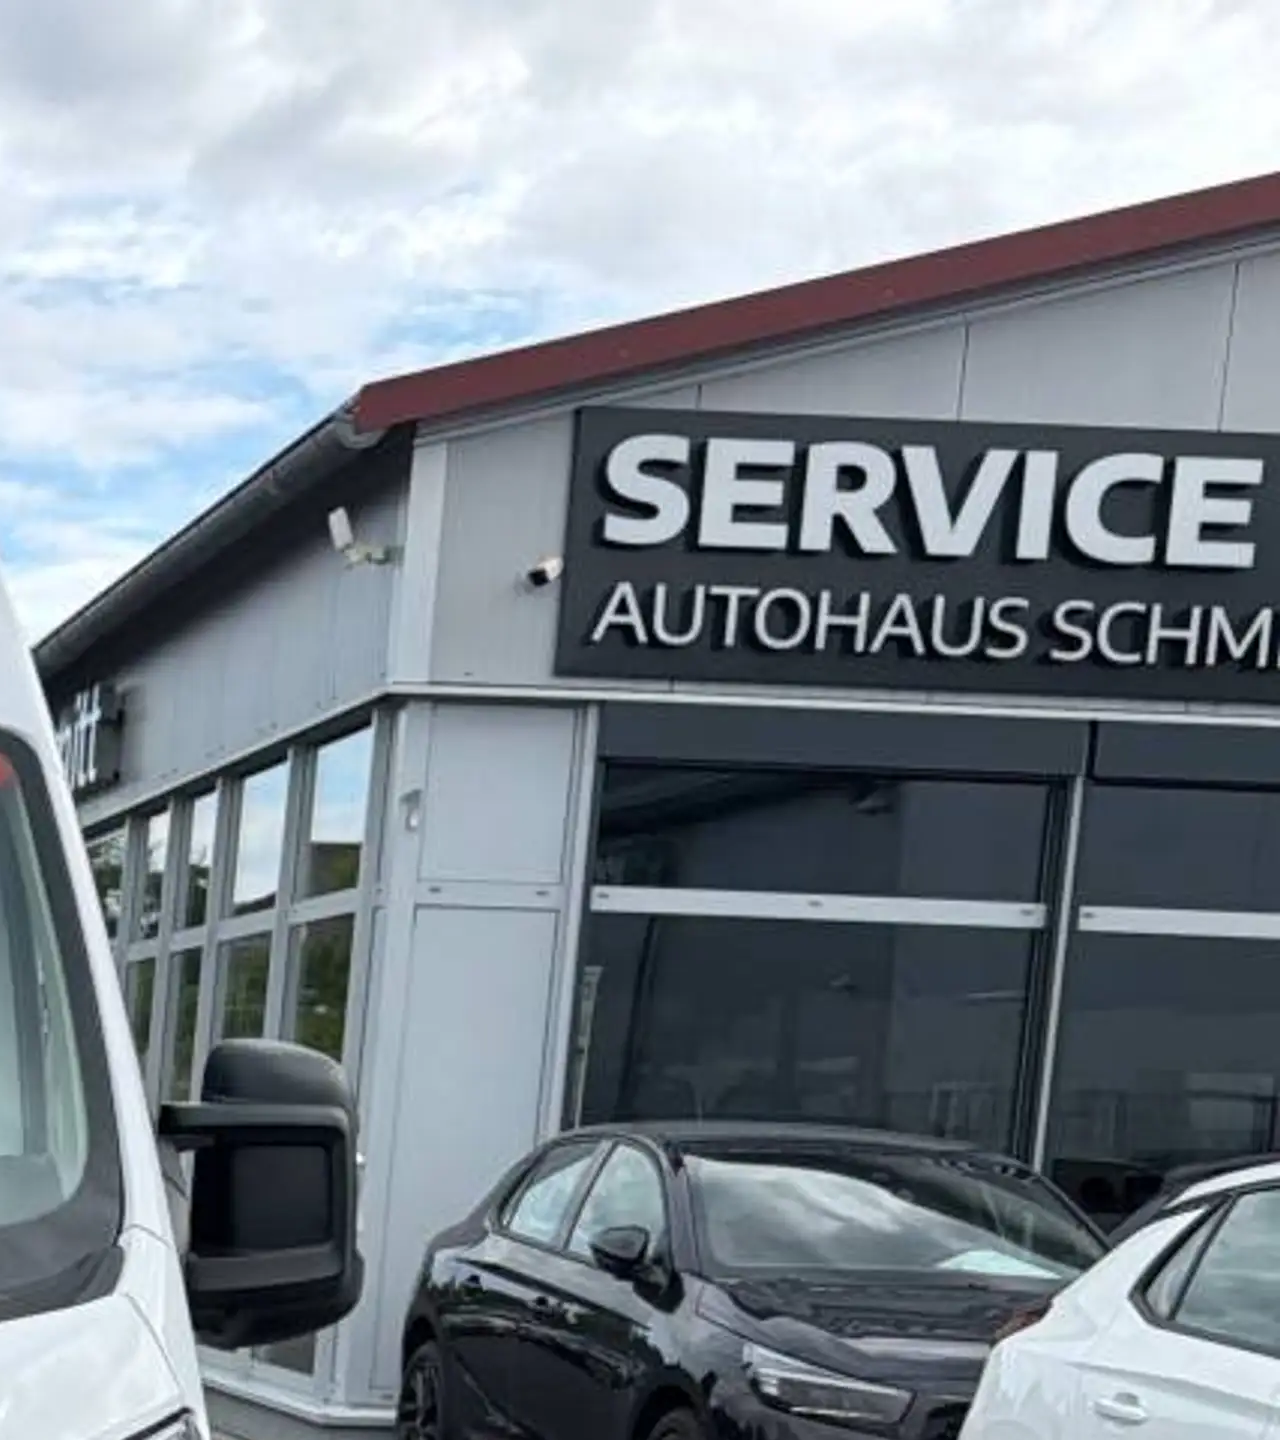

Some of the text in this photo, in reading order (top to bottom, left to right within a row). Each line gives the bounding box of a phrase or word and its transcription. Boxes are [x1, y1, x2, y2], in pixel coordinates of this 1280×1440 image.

[603, 434, 1264, 568] SERVICE
[592, 581, 1280, 670] AUTOHAUS SCHM
